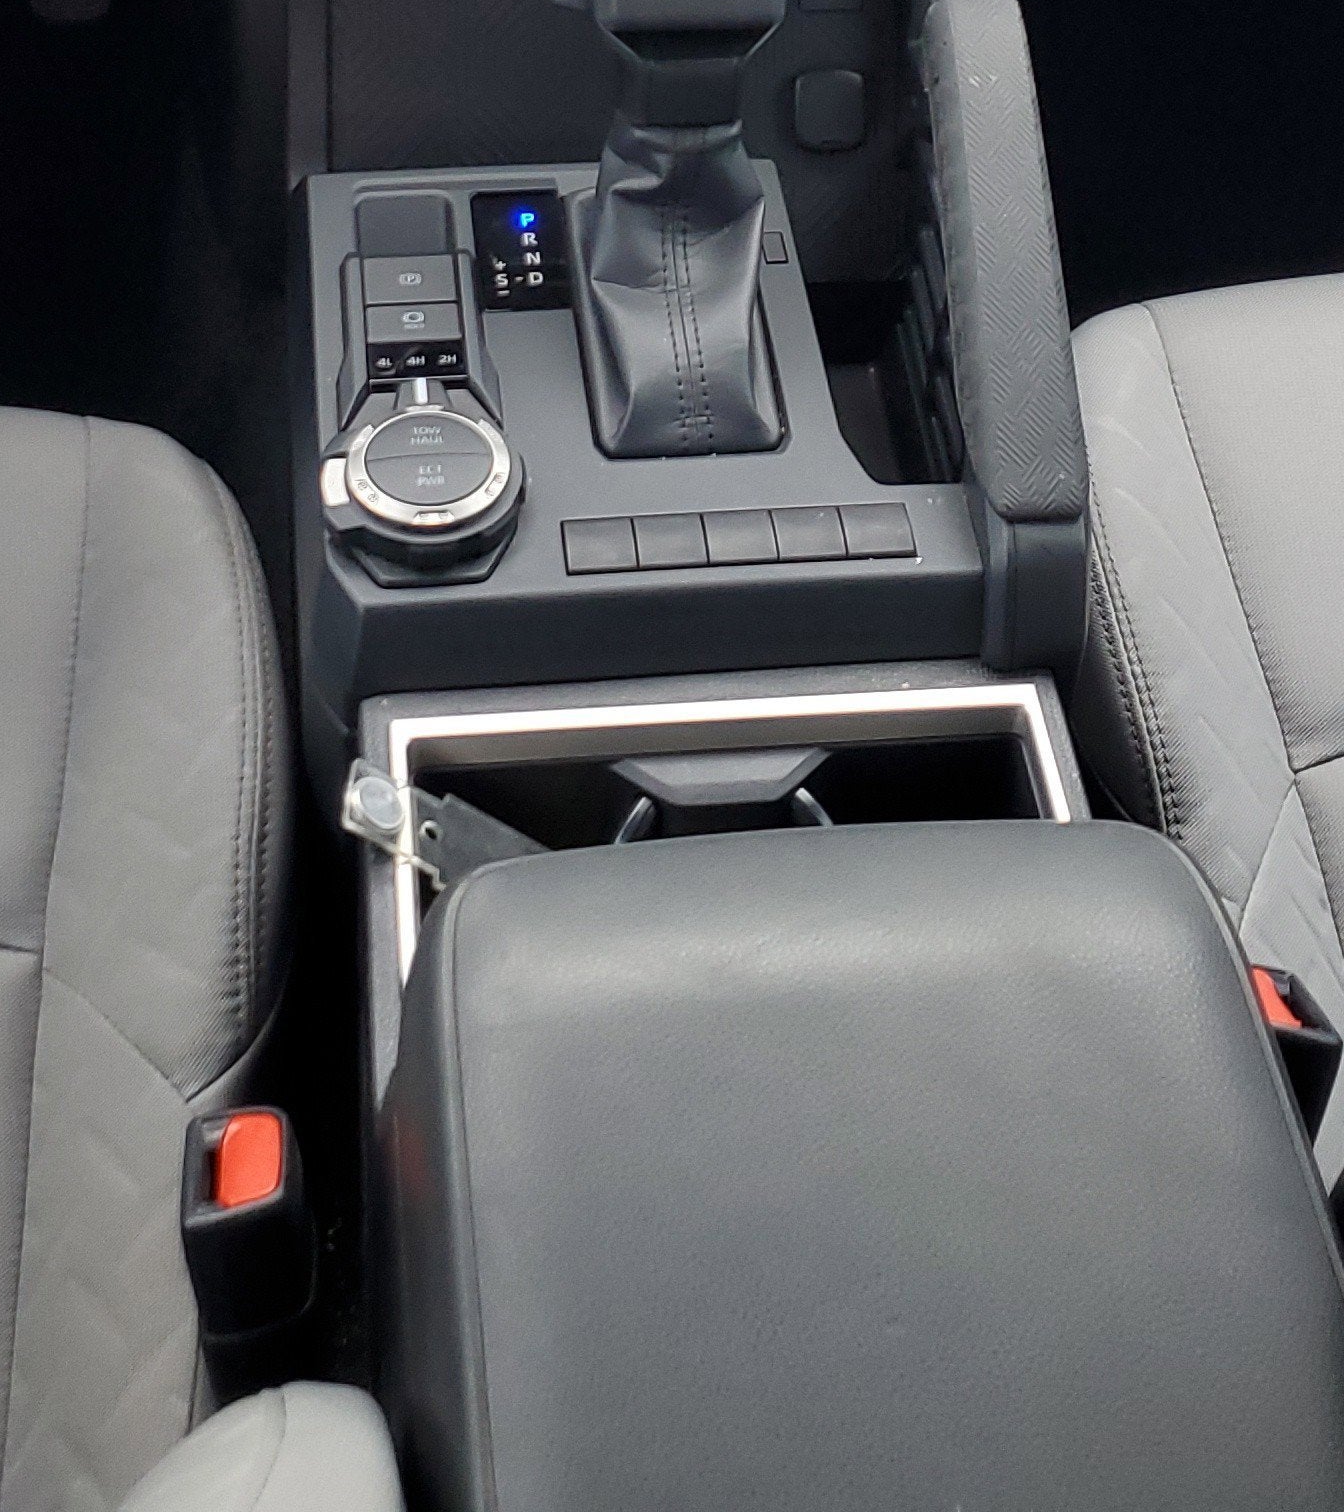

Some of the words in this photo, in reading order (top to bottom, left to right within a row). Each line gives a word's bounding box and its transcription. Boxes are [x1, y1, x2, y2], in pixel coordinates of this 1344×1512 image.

[520, 212, 535, 228] P
[521, 232, 538, 247] R
[524, 251, 541, 266] N
[496, 273, 509, 288] S
[528, 271, 544, 286] D
[376, 356, 393, 367] 4L
[407, 355, 426, 366] 4H
[438, 353, 457, 365] 2H
